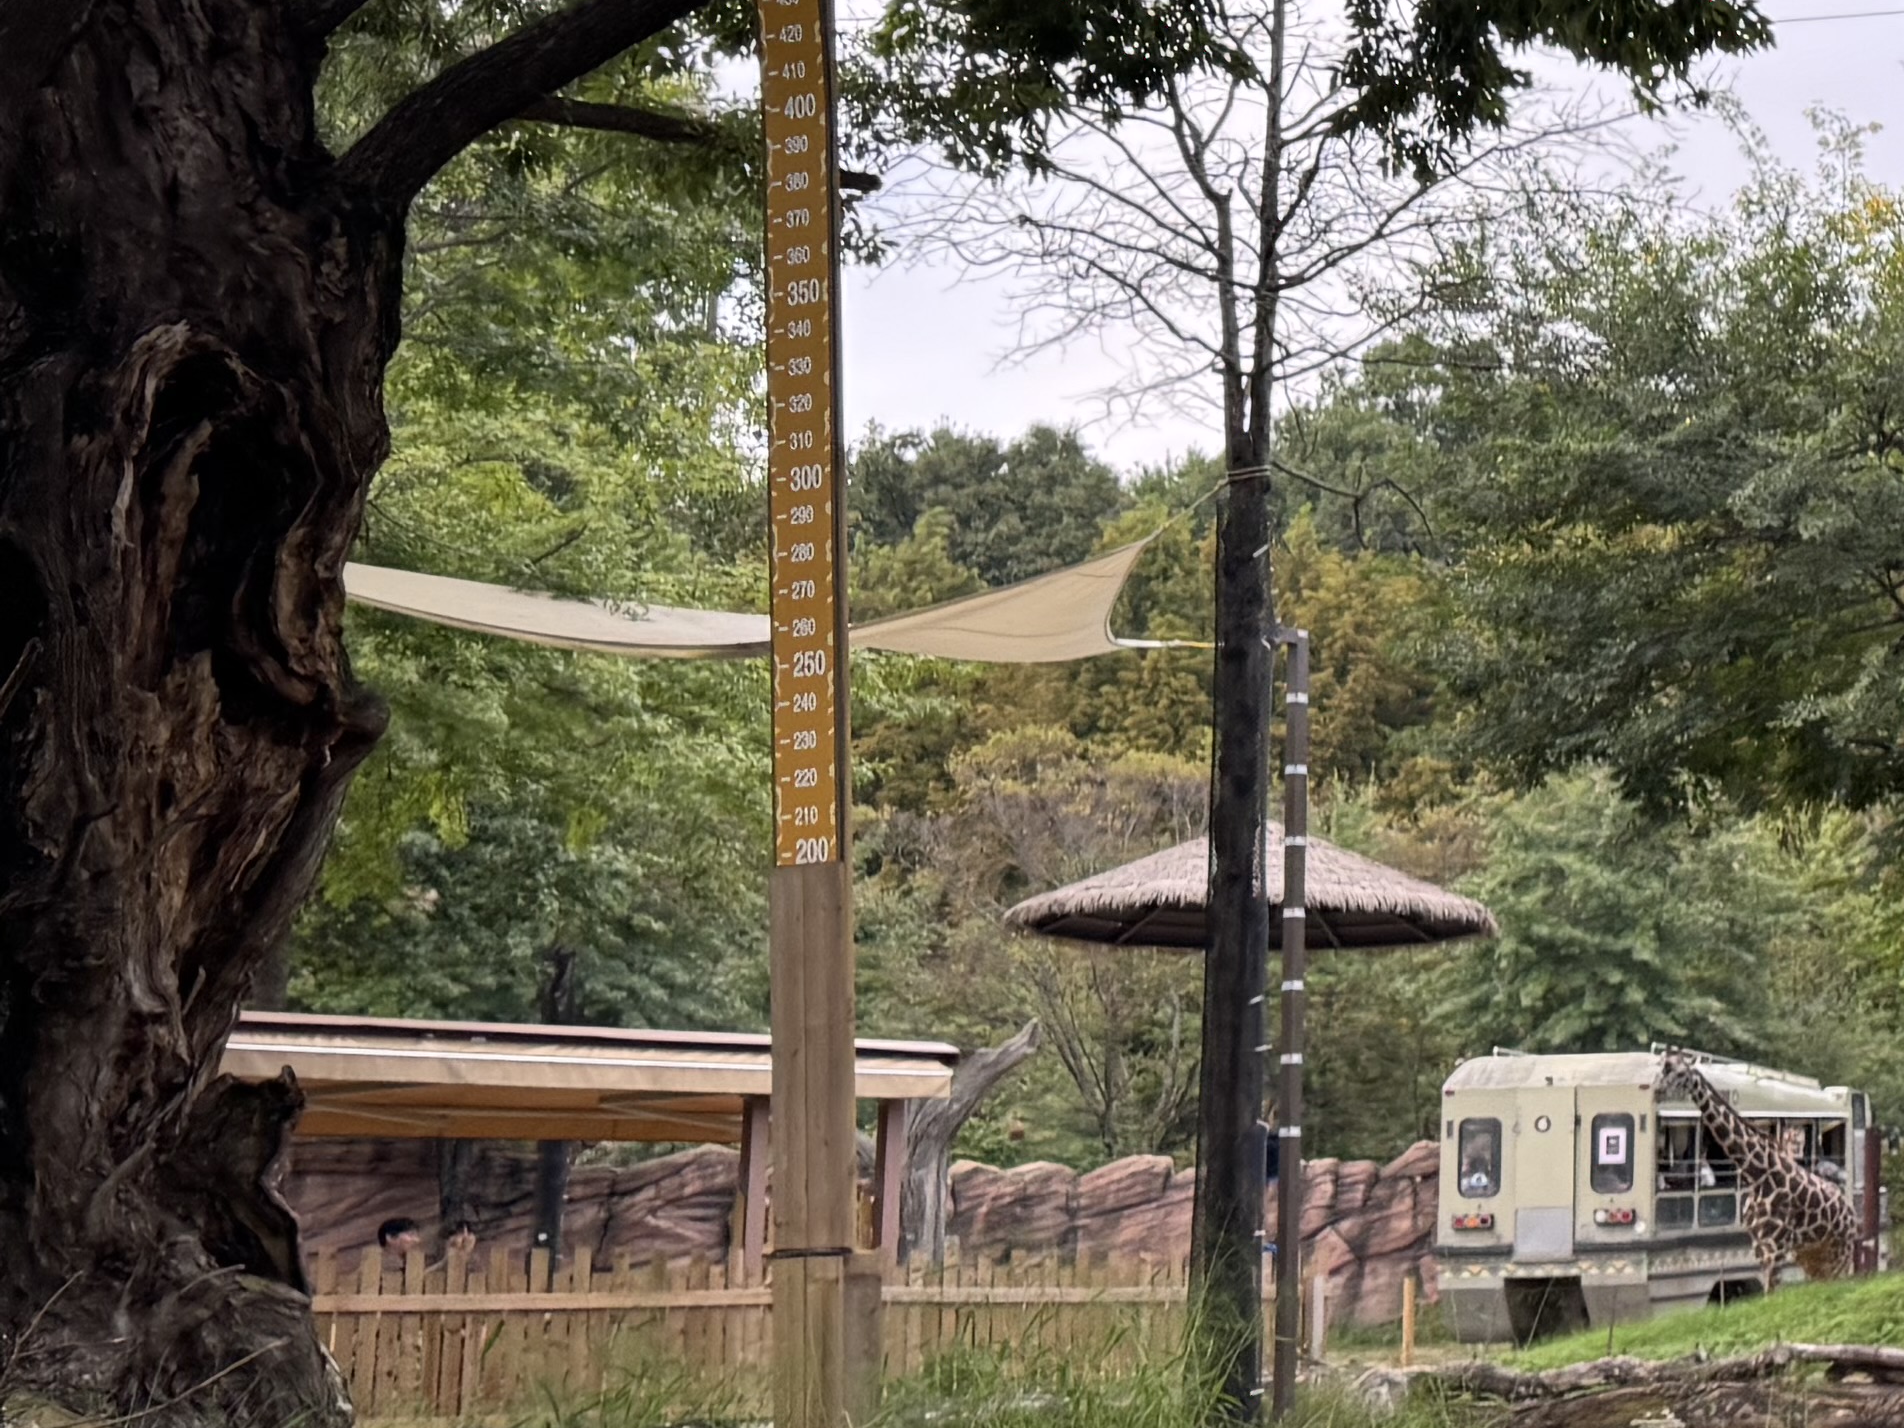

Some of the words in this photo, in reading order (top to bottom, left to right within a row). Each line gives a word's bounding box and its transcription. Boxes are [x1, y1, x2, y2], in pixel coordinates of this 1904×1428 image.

[779, 24, 803, 43] 420
[782, 60, 806, 80] 410
[784, 93, 816, 120] 400
[785, 208, 810, 229] 370
[787, 278, 820, 307] 350
[787, 318, 812, 340] 340
[787, 356, 812, 377] 330
[788, 392, 813, 413] 320
[789, 430, 813, 451] 310
[790, 463, 822, 492] 300
[790, 504, 814, 525] 290
[790, 542, 815, 563] 280
[791, 579, 816, 600] 270
[792, 617, 816, 638] 260
[793, 649, 826, 678] 250
[793, 691, 817, 713] 240
[793, 729, 817, 750] 230
[793, 767, 818, 788] 220
[794, 805, 819, 826] 210
[795, 836, 829, 865] 200
